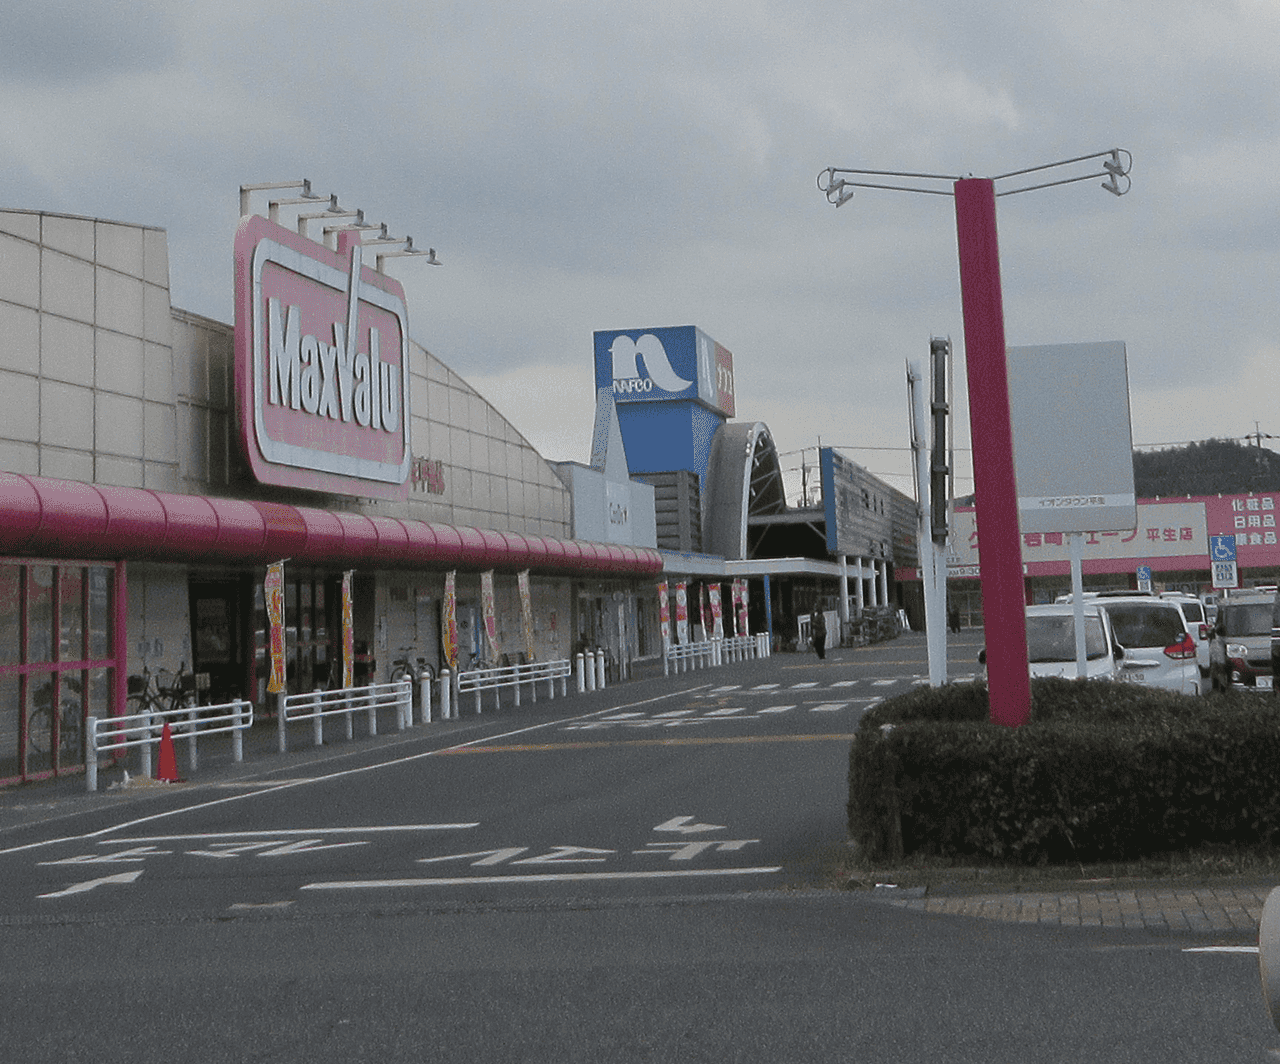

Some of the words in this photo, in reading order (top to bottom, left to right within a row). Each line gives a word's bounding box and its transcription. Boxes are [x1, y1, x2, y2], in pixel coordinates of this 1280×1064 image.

[267, 248, 399, 433] MaxValu
[613, 378, 652, 393] NAFCO
[1039, 496, 1105, 507] イオンタウン平生
[1232, 497, 1275, 512] 化粧品
[1234, 514, 1277, 529] 日用品
[1146, 527, 1193, 542] 平生店
